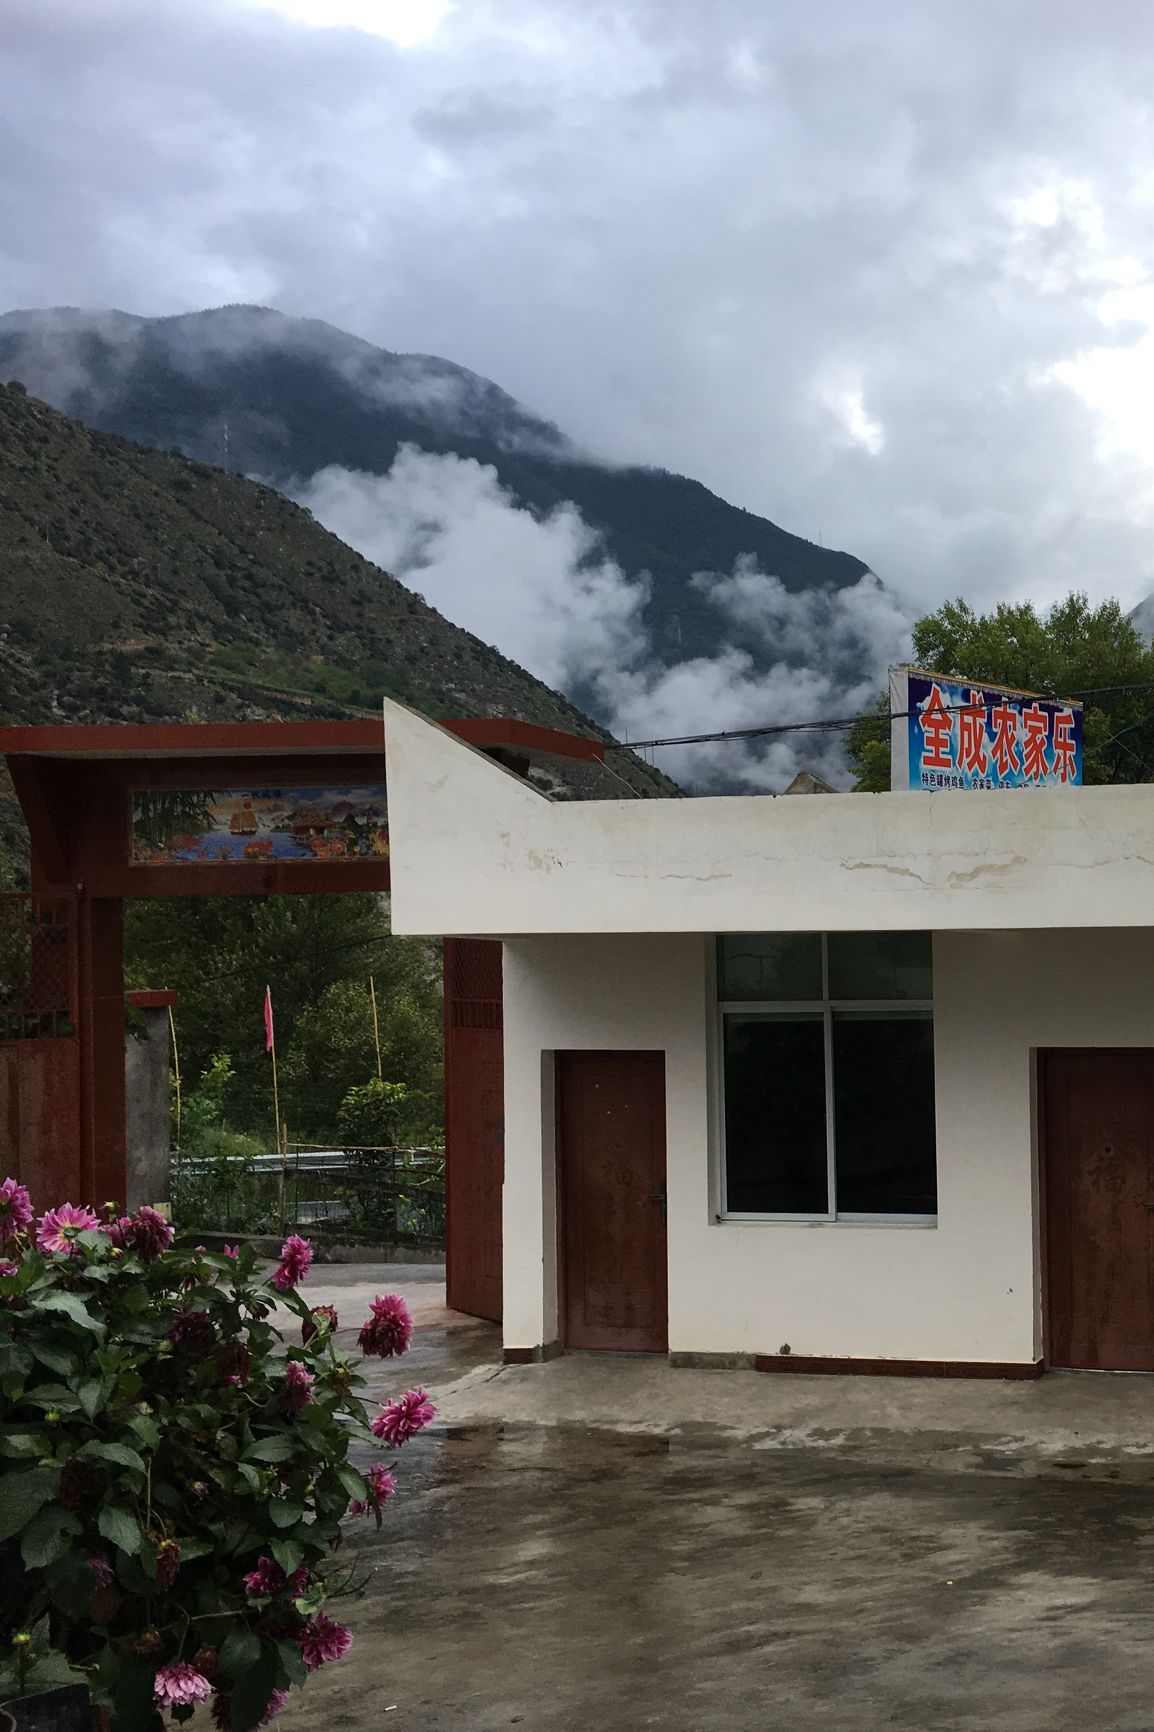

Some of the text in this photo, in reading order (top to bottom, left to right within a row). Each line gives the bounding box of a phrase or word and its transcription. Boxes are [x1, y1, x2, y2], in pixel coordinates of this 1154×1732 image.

[920, 683, 1077, 784] 全成农家乐
